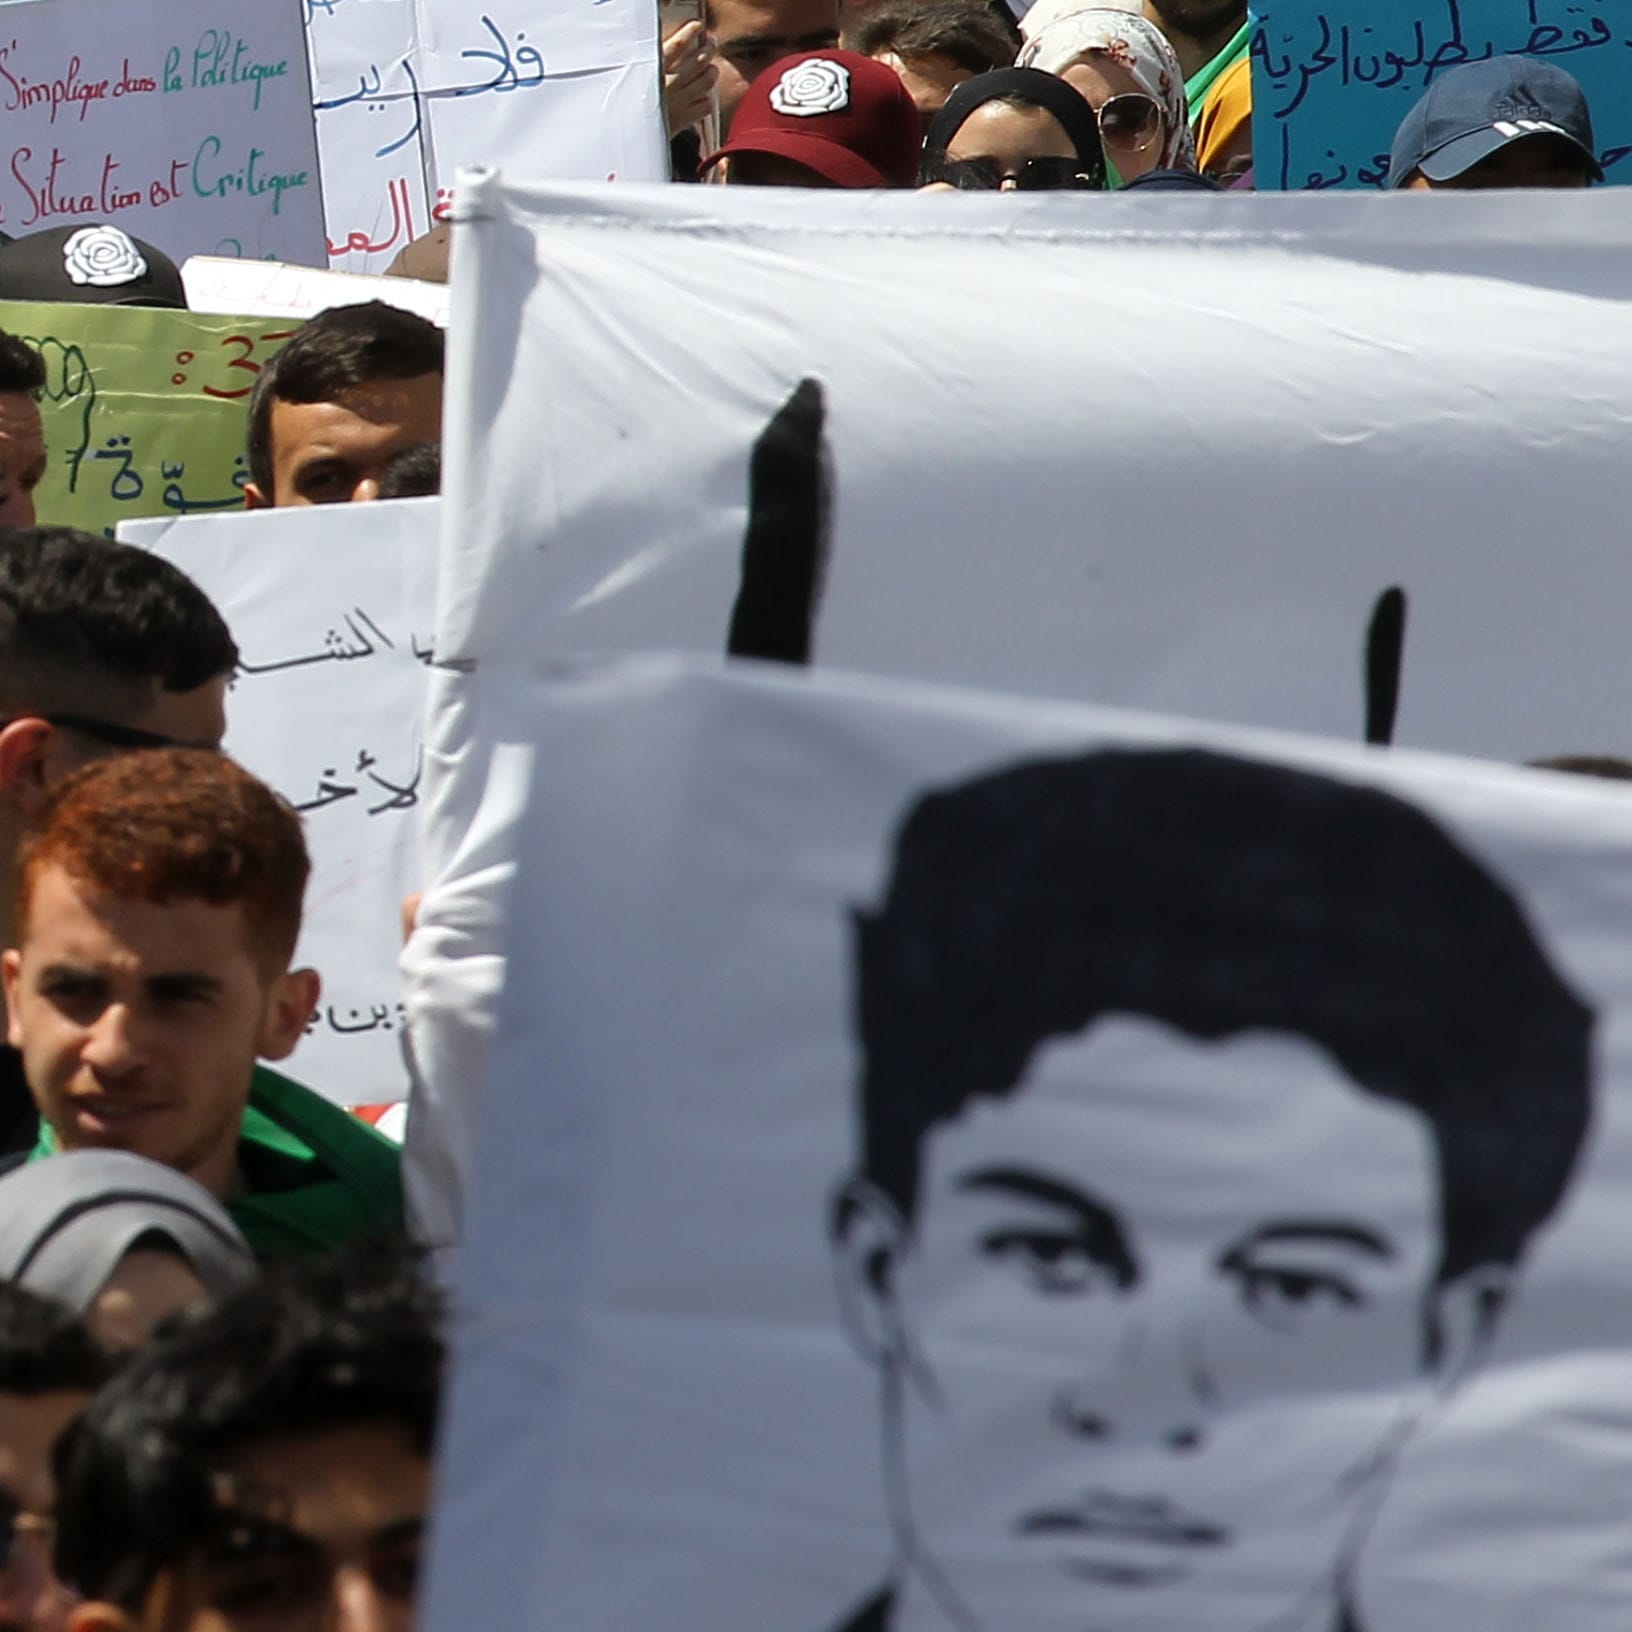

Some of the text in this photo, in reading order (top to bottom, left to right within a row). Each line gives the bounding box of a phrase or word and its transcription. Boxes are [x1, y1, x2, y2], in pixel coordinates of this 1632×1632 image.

[113, 59, 156, 97] dans
[163, 47, 183, 94] la
[11, 147, 141, 225] Situation
[150, 159, 189, 207] est
[191, 135, 308, 215] Critique
